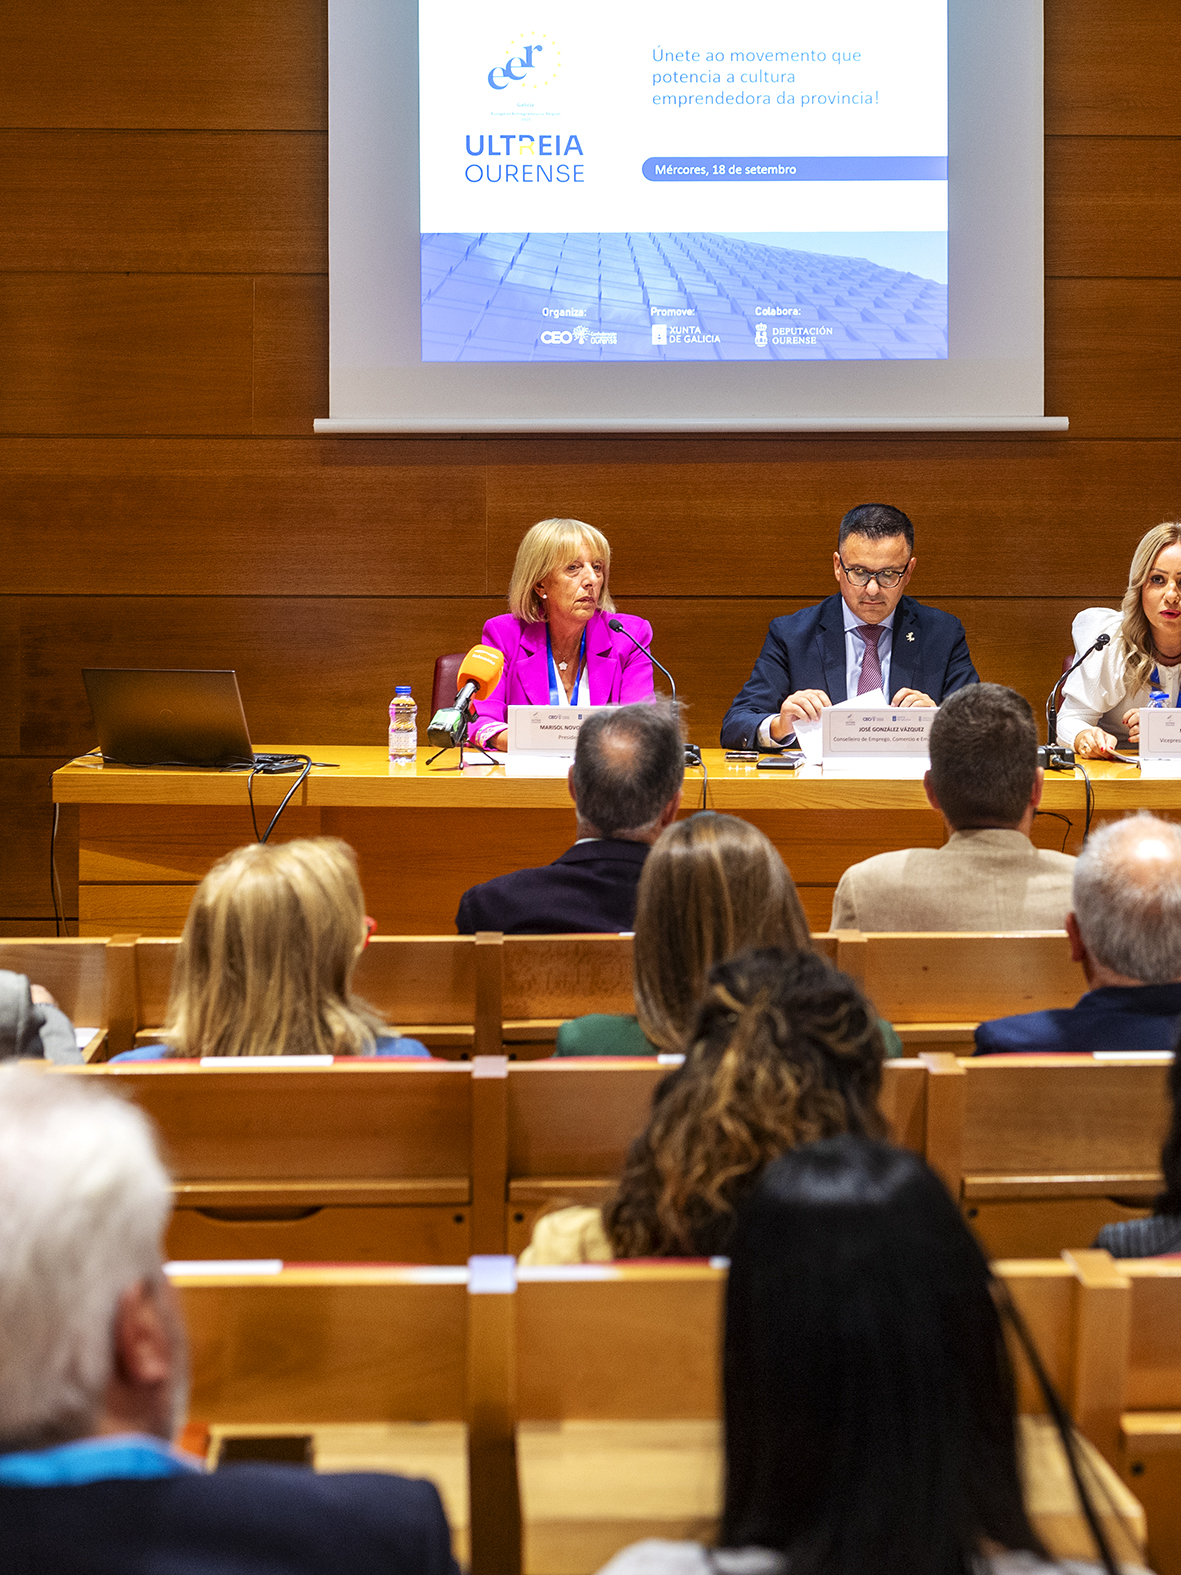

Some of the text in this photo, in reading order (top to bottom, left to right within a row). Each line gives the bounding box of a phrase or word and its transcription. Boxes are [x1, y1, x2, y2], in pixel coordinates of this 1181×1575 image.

[652, 45, 862, 64] Únete ao movemento que
[488, 44, 543, 90] eer
[652, 69, 795, 86] potencia a cultura
[652, 90, 879, 108] emprendedora da provincia!
[466, 134, 584, 156] ULTREIA
[465, 164, 585, 183] OURENSE
[655, 164, 797, 177] Mércores, 18 de setembro
[542, 307, 587, 319] Organiza:
[650, 306, 695, 317] Promove:
[754, 306, 802, 316] Colabora:
[670, 326, 701, 334] XUNTA
[772, 326, 833, 336] DEPUTACIÓN
[540, 330, 573, 344] CEO
[670, 335, 721, 344] DE GALICIA
[772, 336, 817, 345] OURENSE
